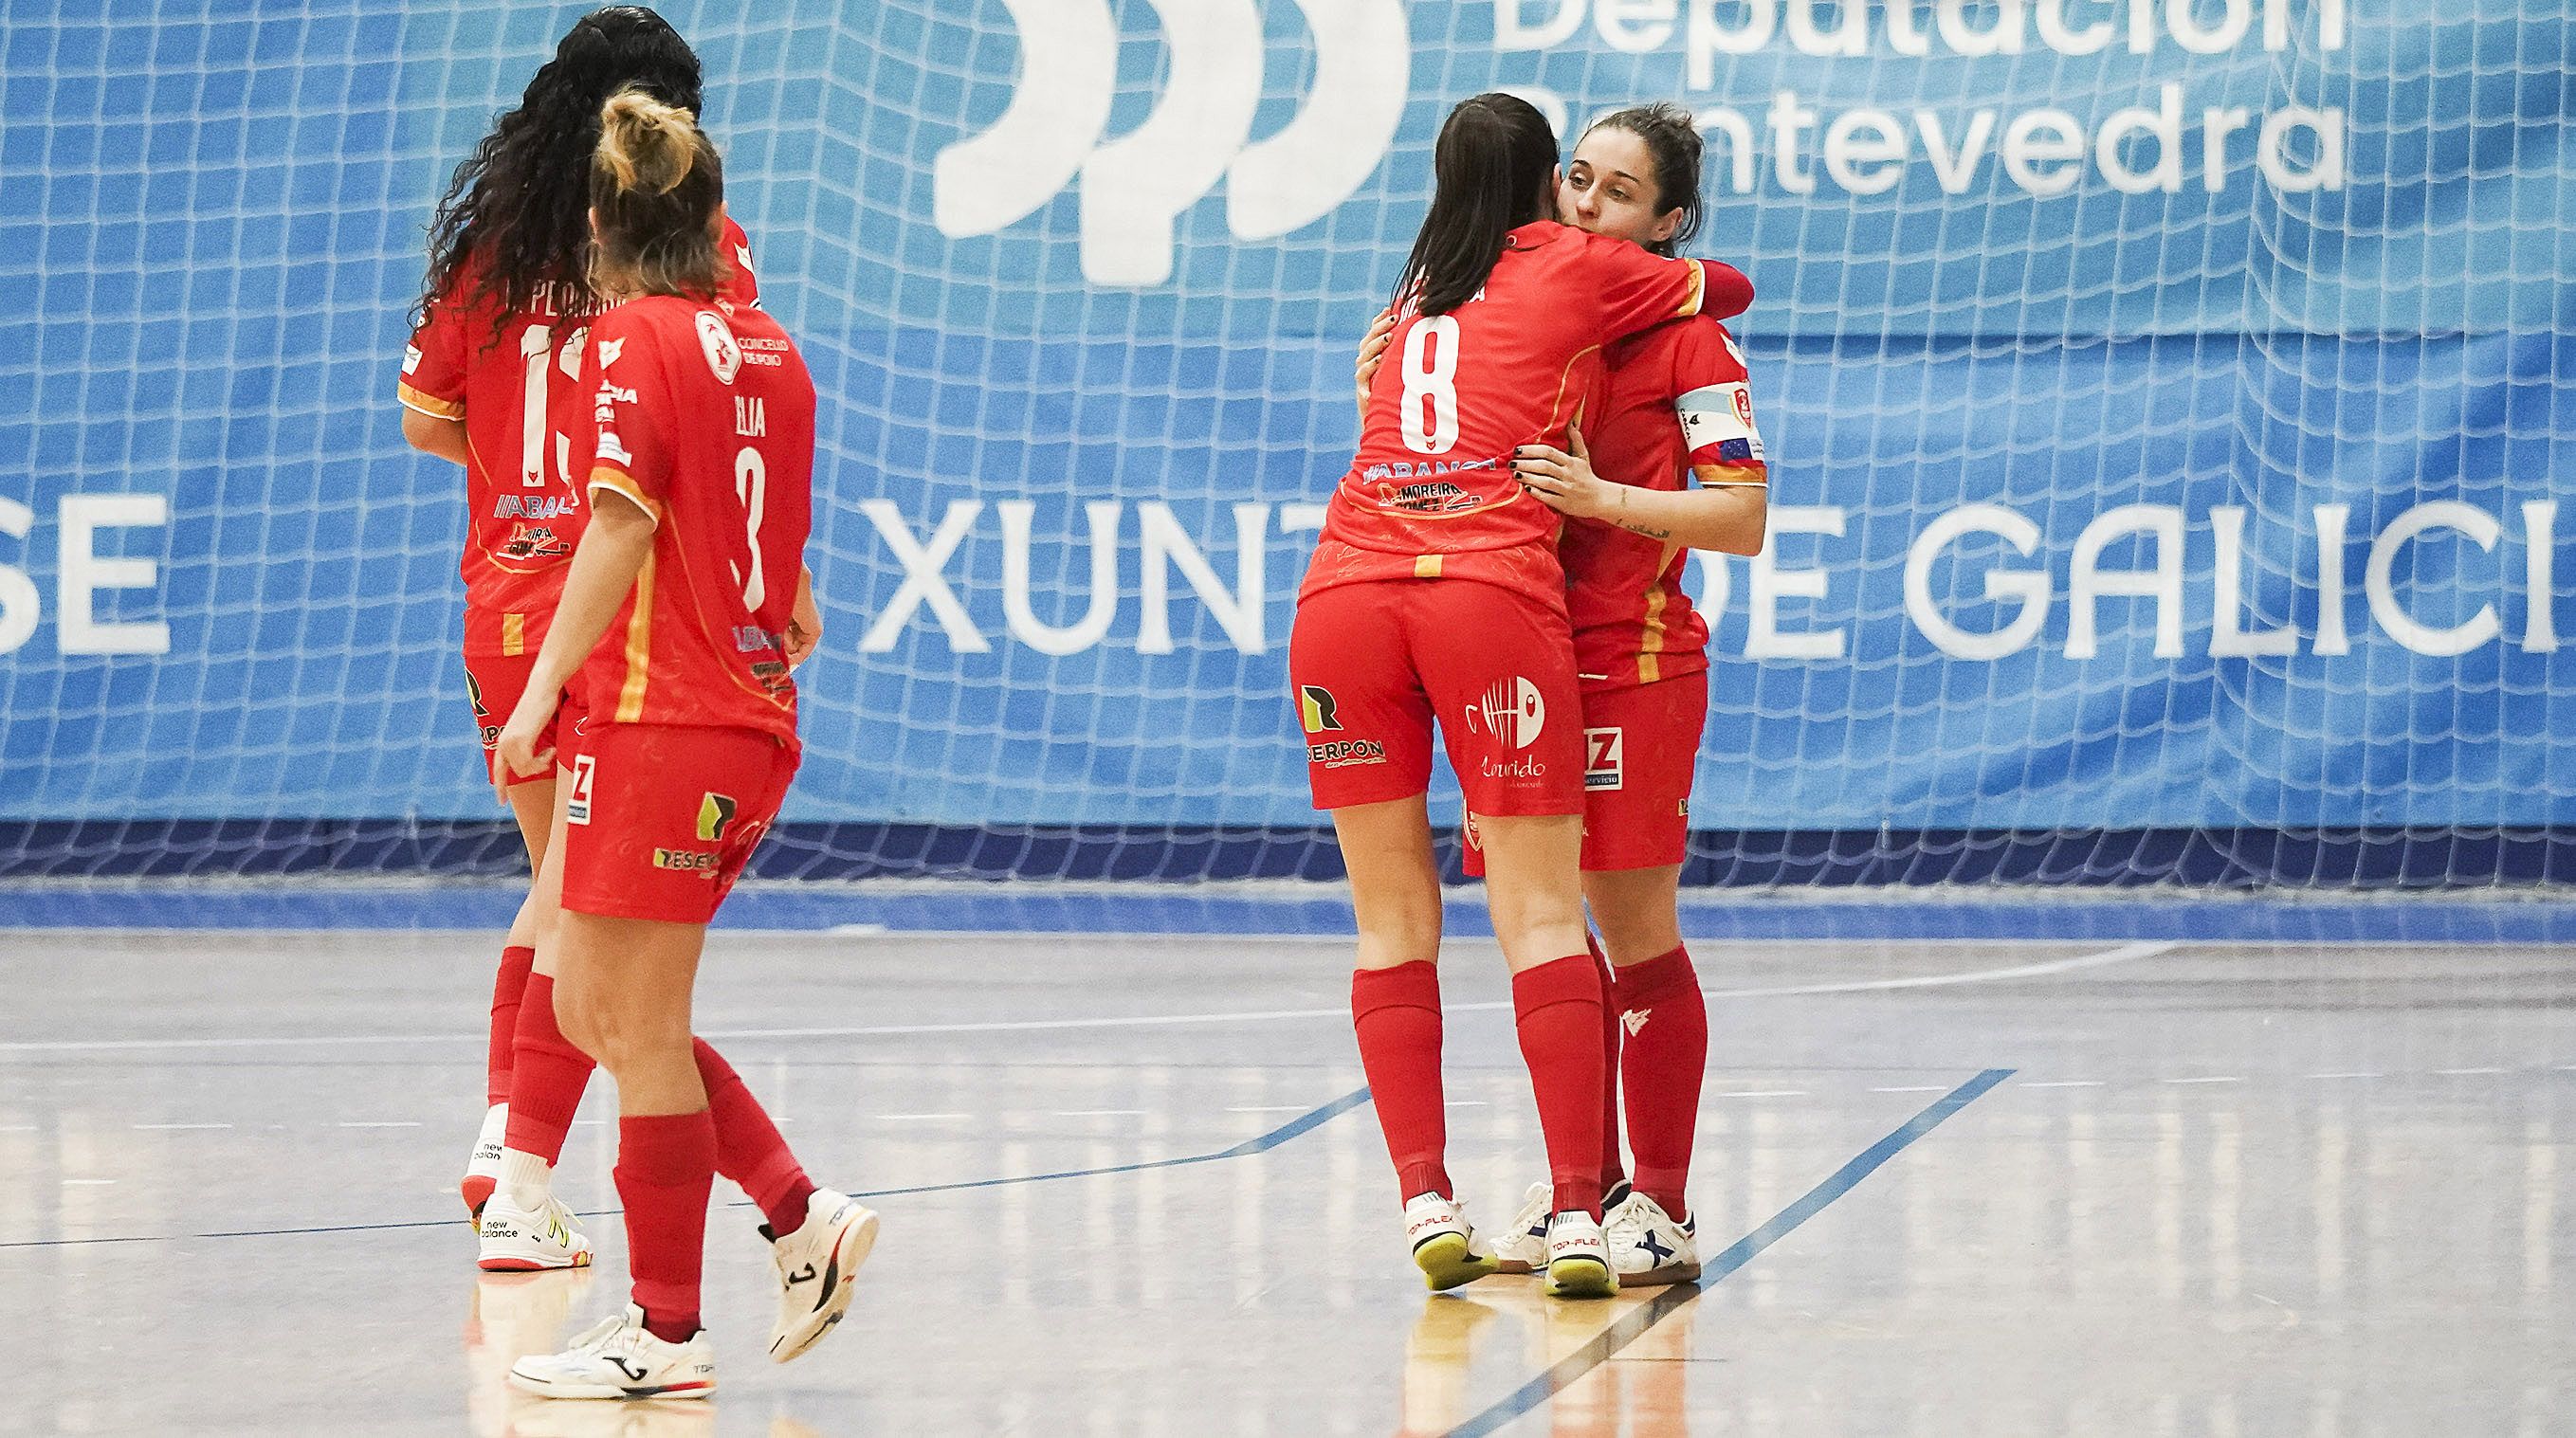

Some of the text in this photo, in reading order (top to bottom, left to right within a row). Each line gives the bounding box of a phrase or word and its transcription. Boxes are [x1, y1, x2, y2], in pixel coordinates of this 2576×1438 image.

[1494, 83, 2345, 193] ntevedra
[1400, 315, 1461, 454] 8
[1400, 482, 1463, 502] MOREIRA
[486, 1221, 508, 1229] new
